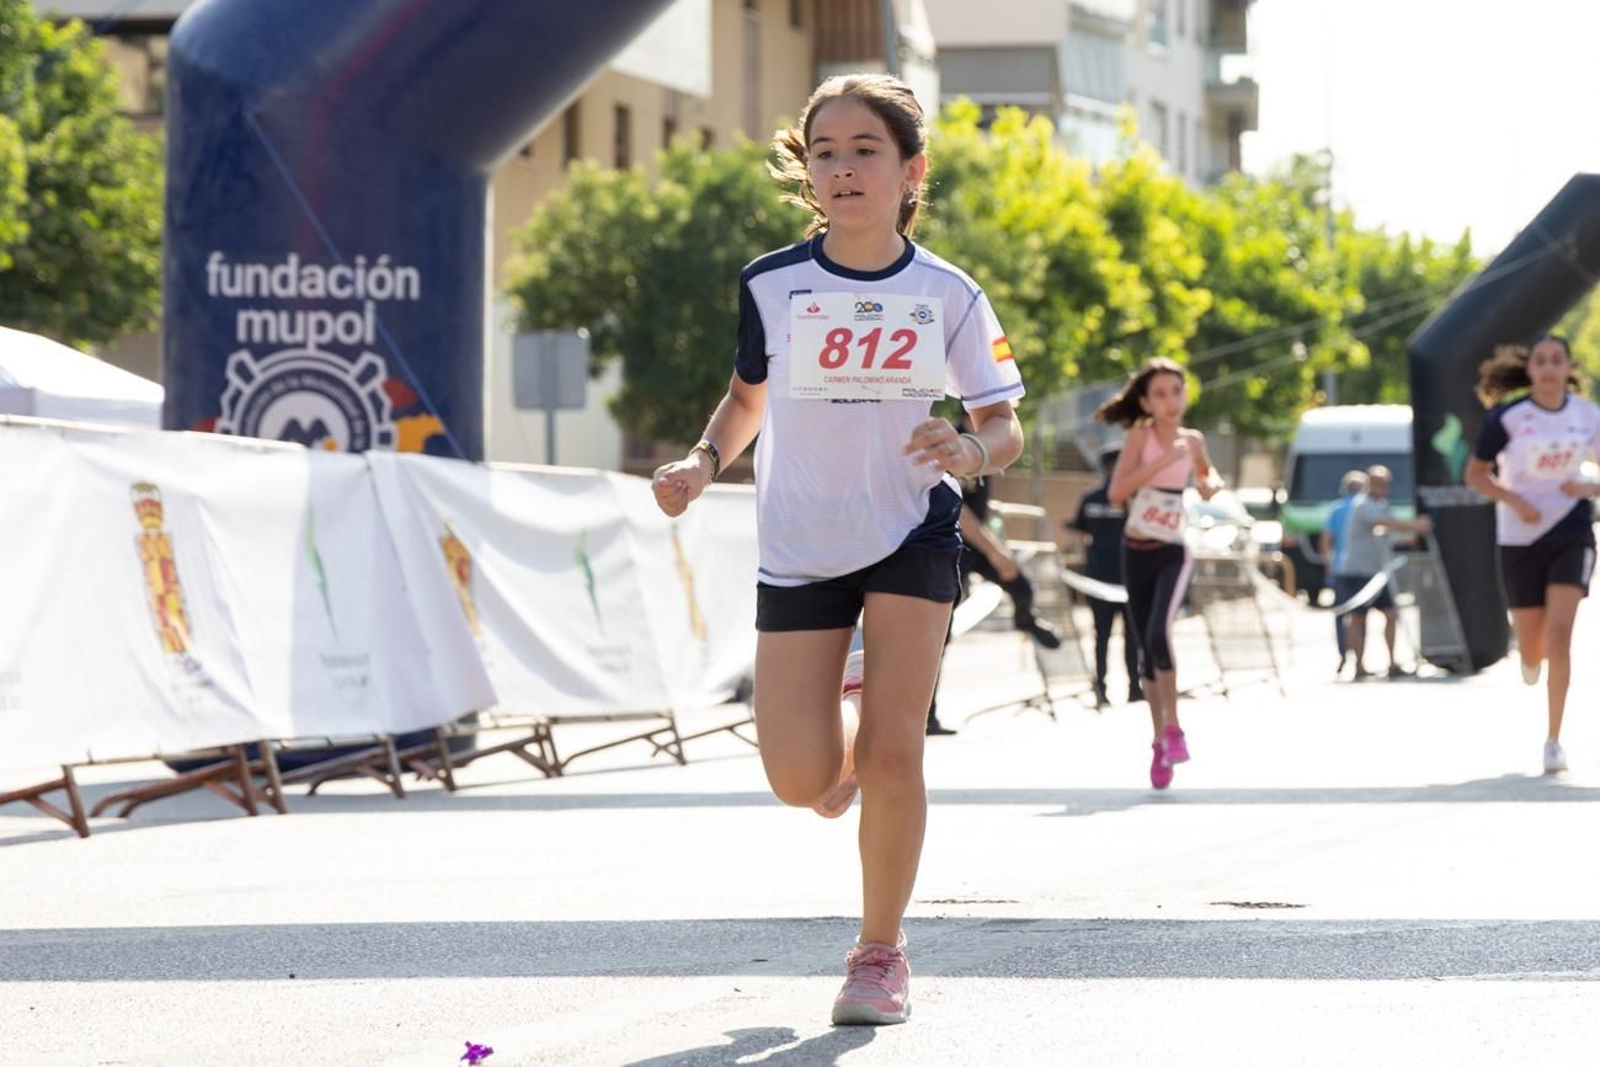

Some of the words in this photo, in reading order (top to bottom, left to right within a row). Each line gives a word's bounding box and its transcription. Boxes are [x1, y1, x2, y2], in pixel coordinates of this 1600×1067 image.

[207, 251, 420, 300] fundación
[236, 299, 375, 352] mupol
[818, 327, 918, 370] 812
[823, 376, 850, 384] CARMEN
[852, 376, 883, 384] PALOMINO
[885, 376, 912, 384] ARANDA
